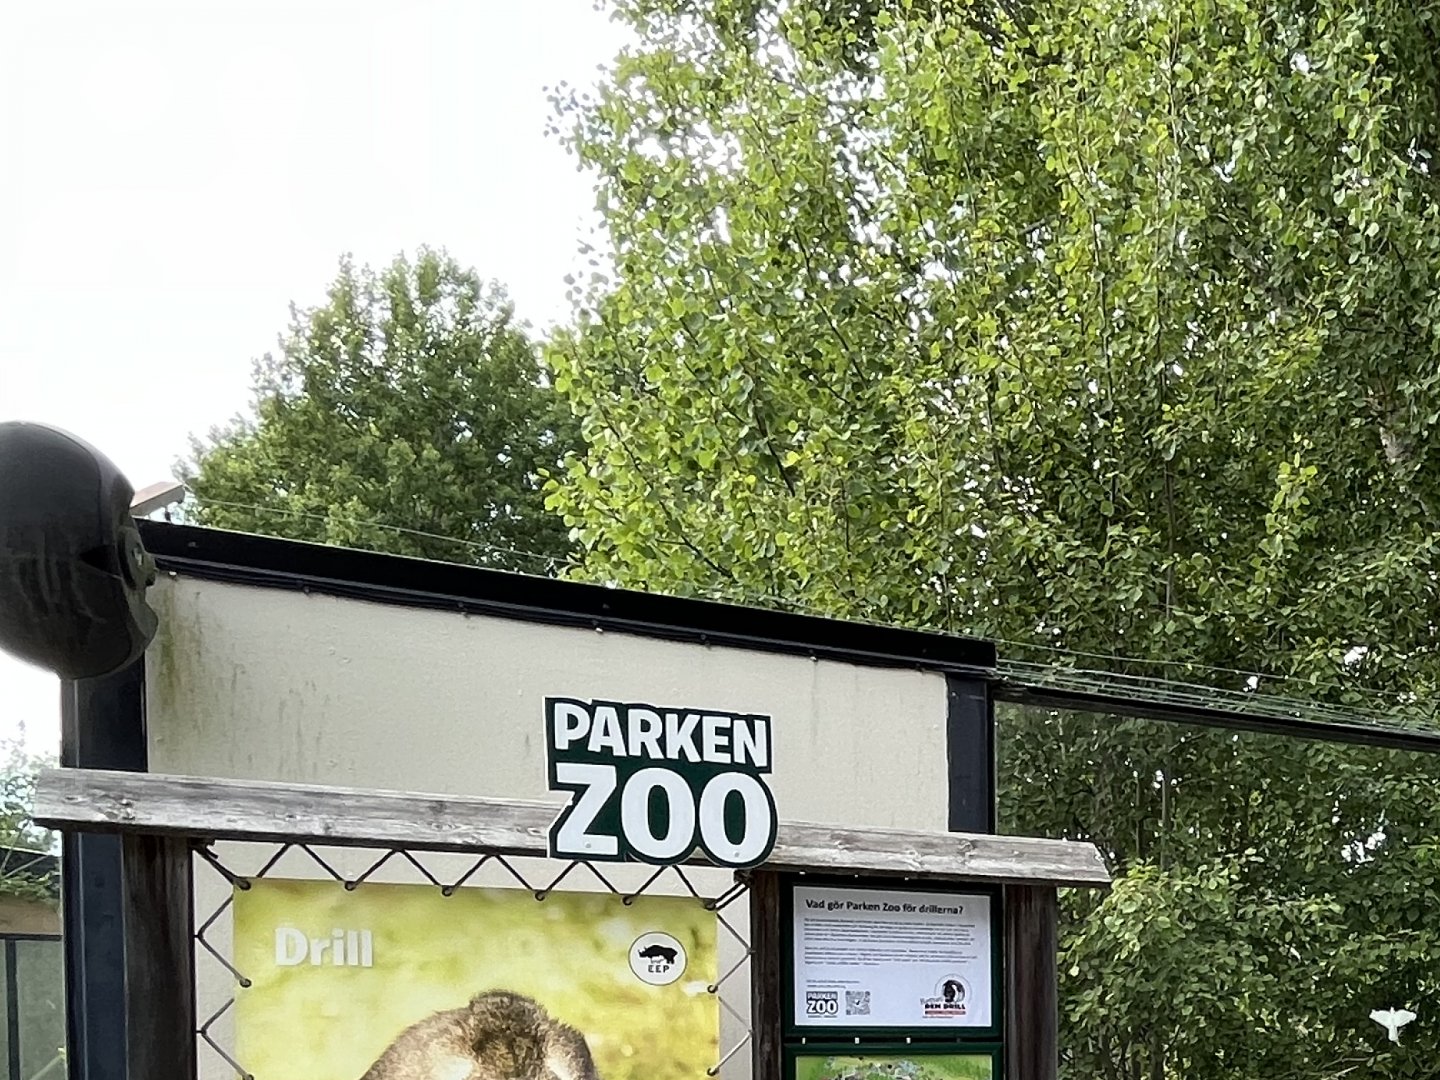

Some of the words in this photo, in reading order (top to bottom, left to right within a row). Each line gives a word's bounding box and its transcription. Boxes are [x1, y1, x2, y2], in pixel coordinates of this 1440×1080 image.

[554, 702, 768, 768] PARKEN
[556, 762, 771, 864] ZOO
[805, 899, 825, 909] Vad
[827, 900, 844, 911] gör
[846, 901, 880, 911] Parken
[882, 902, 900, 912] Zoo
[902, 903, 917, 912] för
[919, 904, 963, 914] drillerna?
[275, 926, 373, 968] Drill
[647, 964, 670, 973] EEP
[807, 1000, 838, 1013] ZOO
